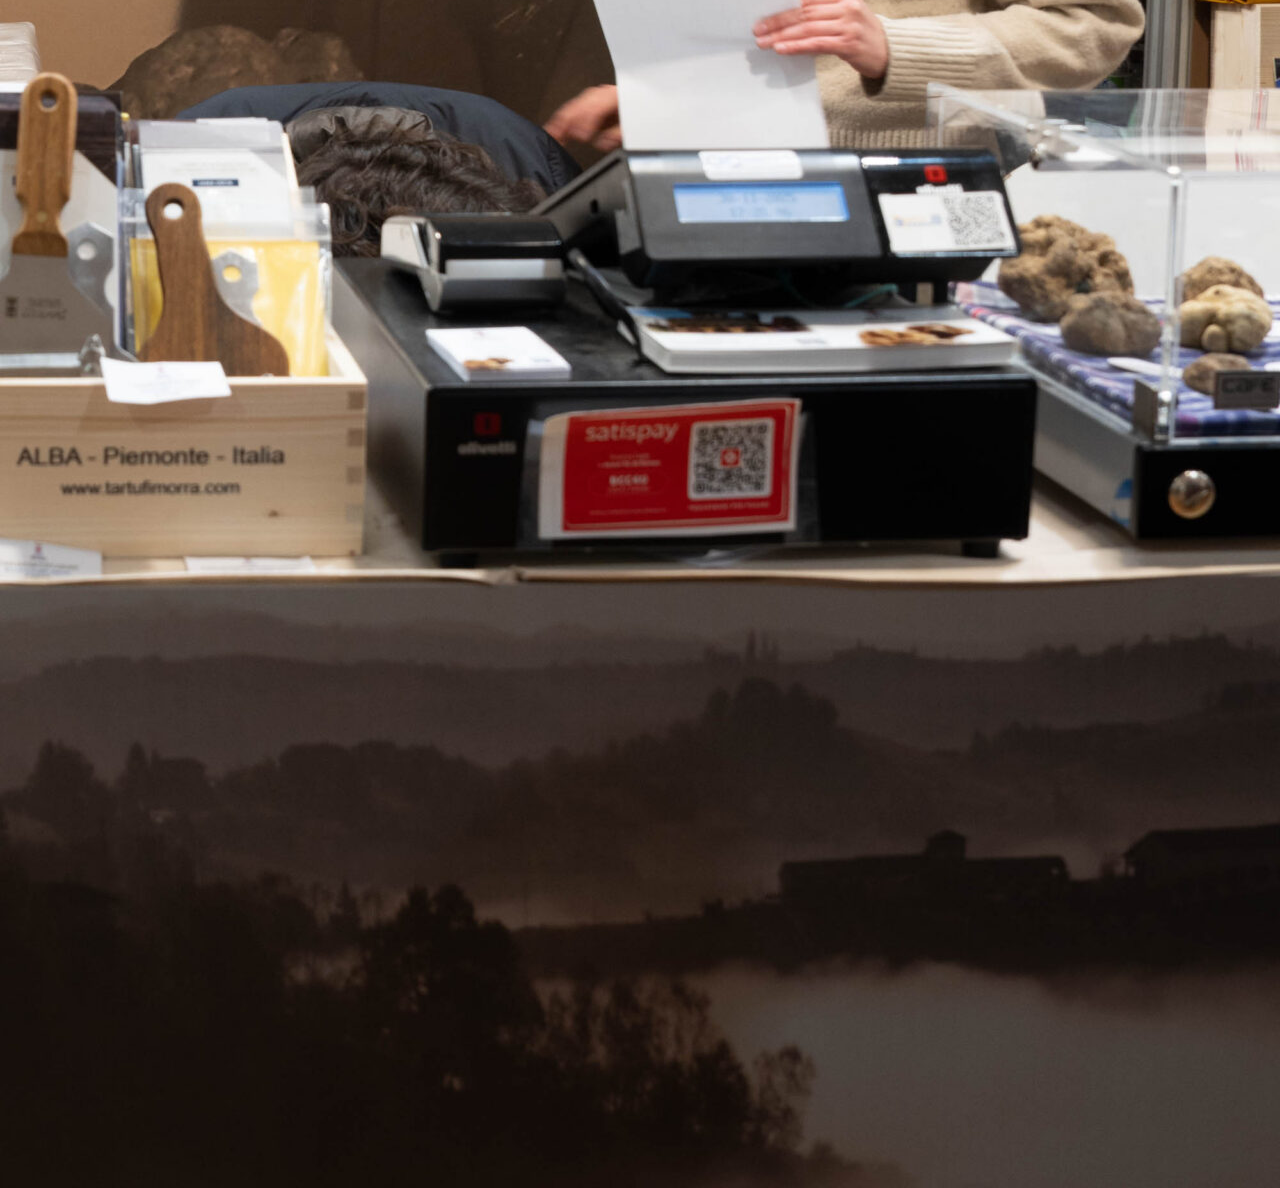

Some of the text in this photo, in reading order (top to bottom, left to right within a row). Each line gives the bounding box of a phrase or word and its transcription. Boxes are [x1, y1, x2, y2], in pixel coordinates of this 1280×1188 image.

[584, 421, 679, 444] satispay
[17, 446, 83, 467] ALBA
[103, 446, 209, 467] Piemonte
[232, 445, 286, 465] Italia
[457, 440, 517, 456] olivetti
[60, 479, 241, 496] www.tartufimorra.com
